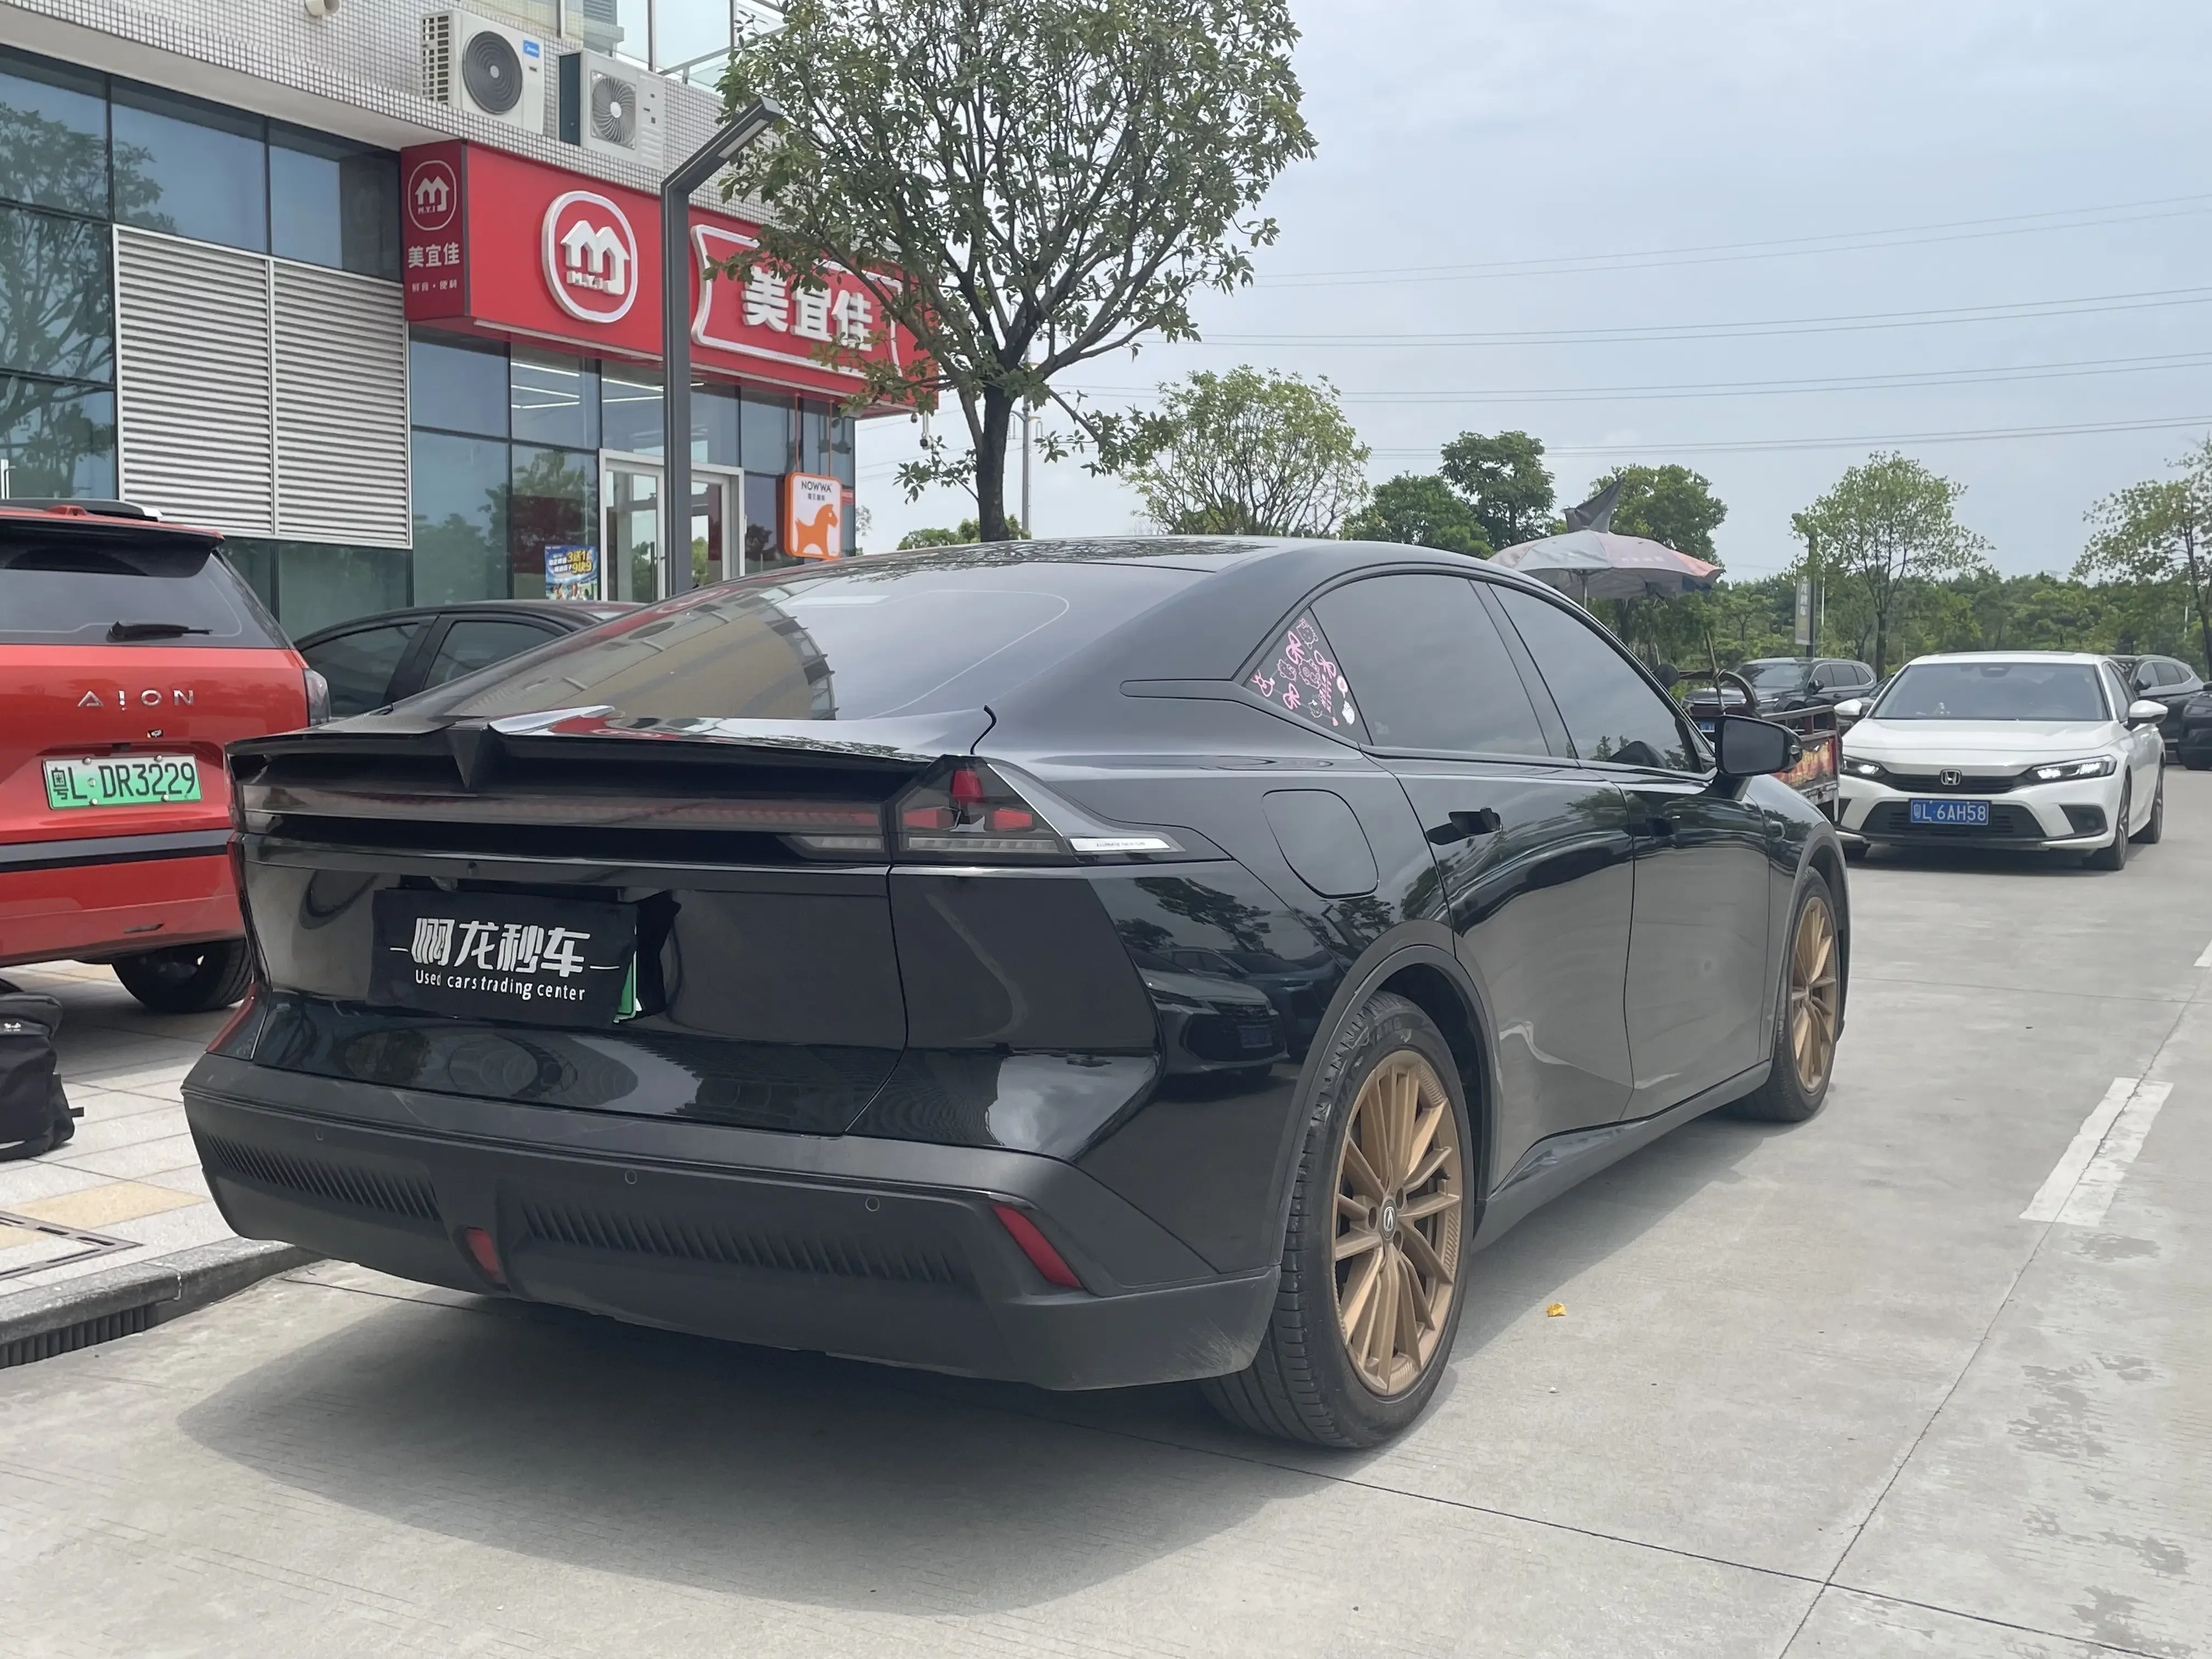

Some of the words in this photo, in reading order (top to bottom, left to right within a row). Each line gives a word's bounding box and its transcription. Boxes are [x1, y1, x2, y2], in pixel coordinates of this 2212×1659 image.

[408, 242, 460, 268] 美宜佳
[741, 266, 873, 352] 美宜佳
[802, 481, 832, 493] NOWWA
[415, 969, 442, 986] Used
[447, 975, 477, 990] cars
[481, 975, 533, 1000] trading
[537, 984, 585, 1001] center
